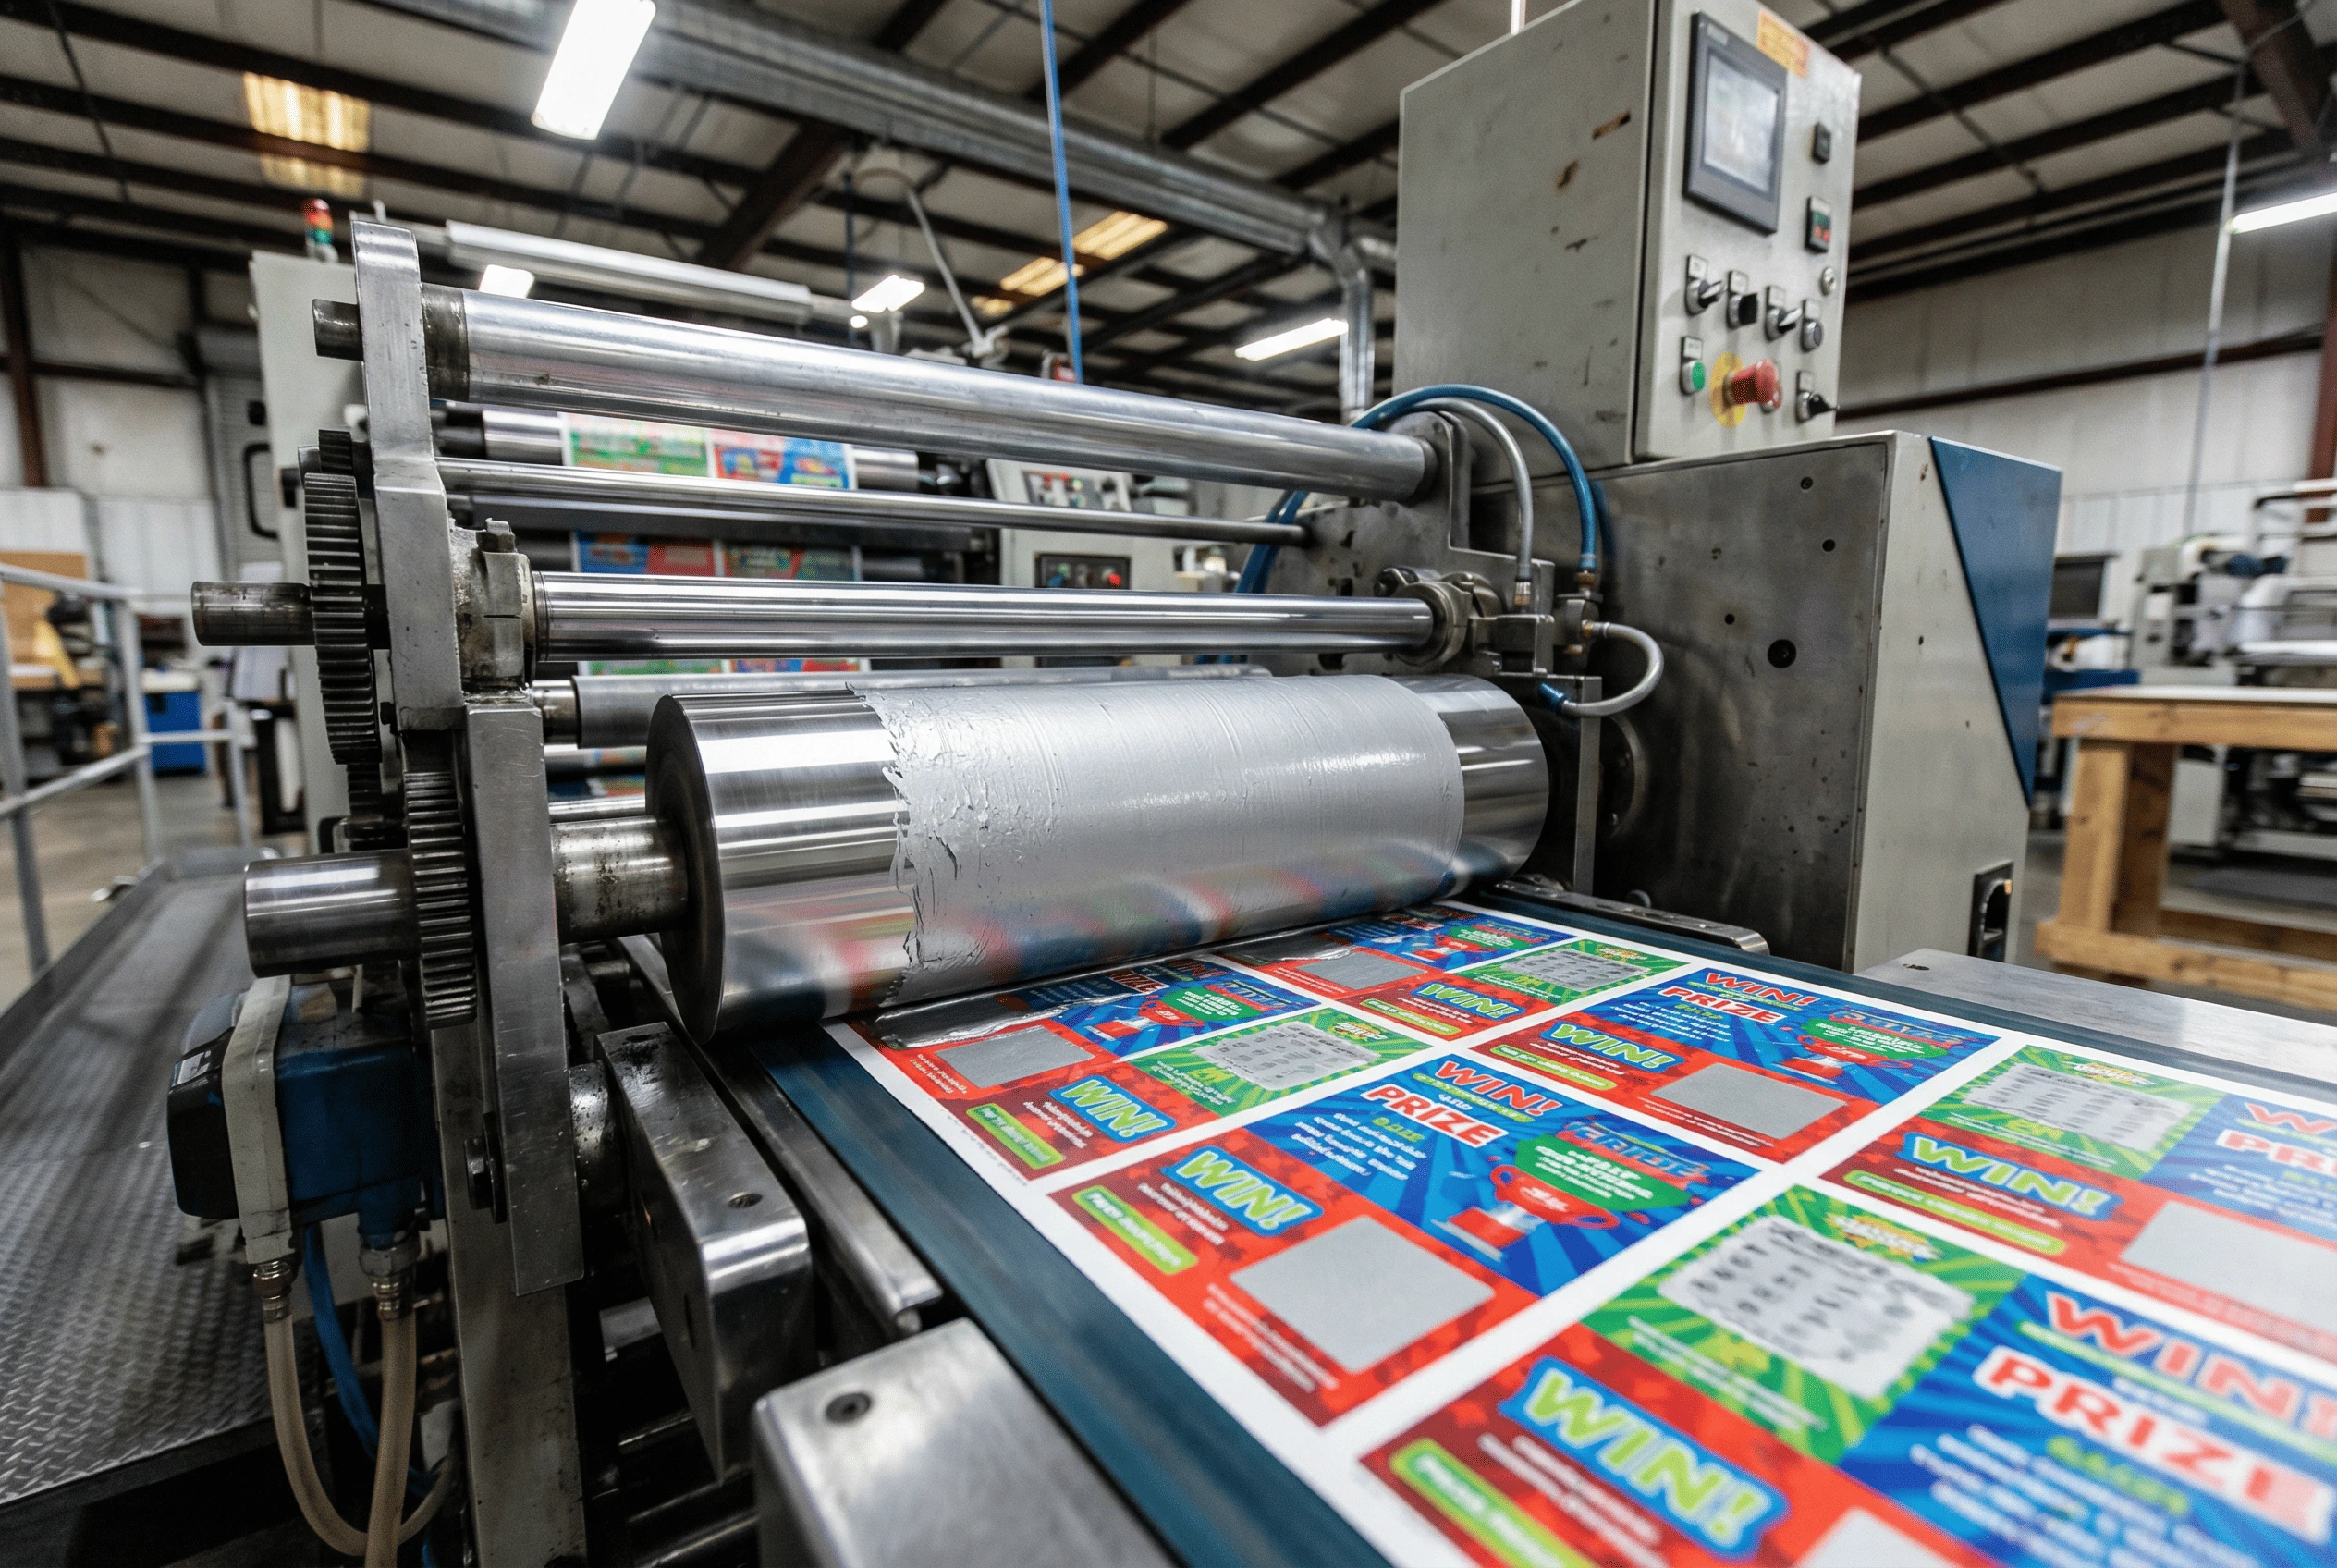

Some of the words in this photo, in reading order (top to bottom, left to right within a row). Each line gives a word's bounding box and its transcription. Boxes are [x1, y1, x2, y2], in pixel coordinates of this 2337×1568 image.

[1419, 983, 1521, 1018] WIN!
[1658, 986, 1788, 1025] PRIZE
[1706, 973, 1820, 1007] WIN!
[1550, 1023, 1676, 1069] WIN!
[1060, 1079, 1168, 1138] WIN!
[1360, 1083, 1509, 1148] PRIZE
[1434, 1060, 1563, 1117] WIN!
[1911, 1134, 2111, 1217] WIN!
[2215, 1129, 2337, 1178] PR
[1175, 1149, 1313, 1231] WIN!
[1523, 1367, 1773, 1550] WIN!
